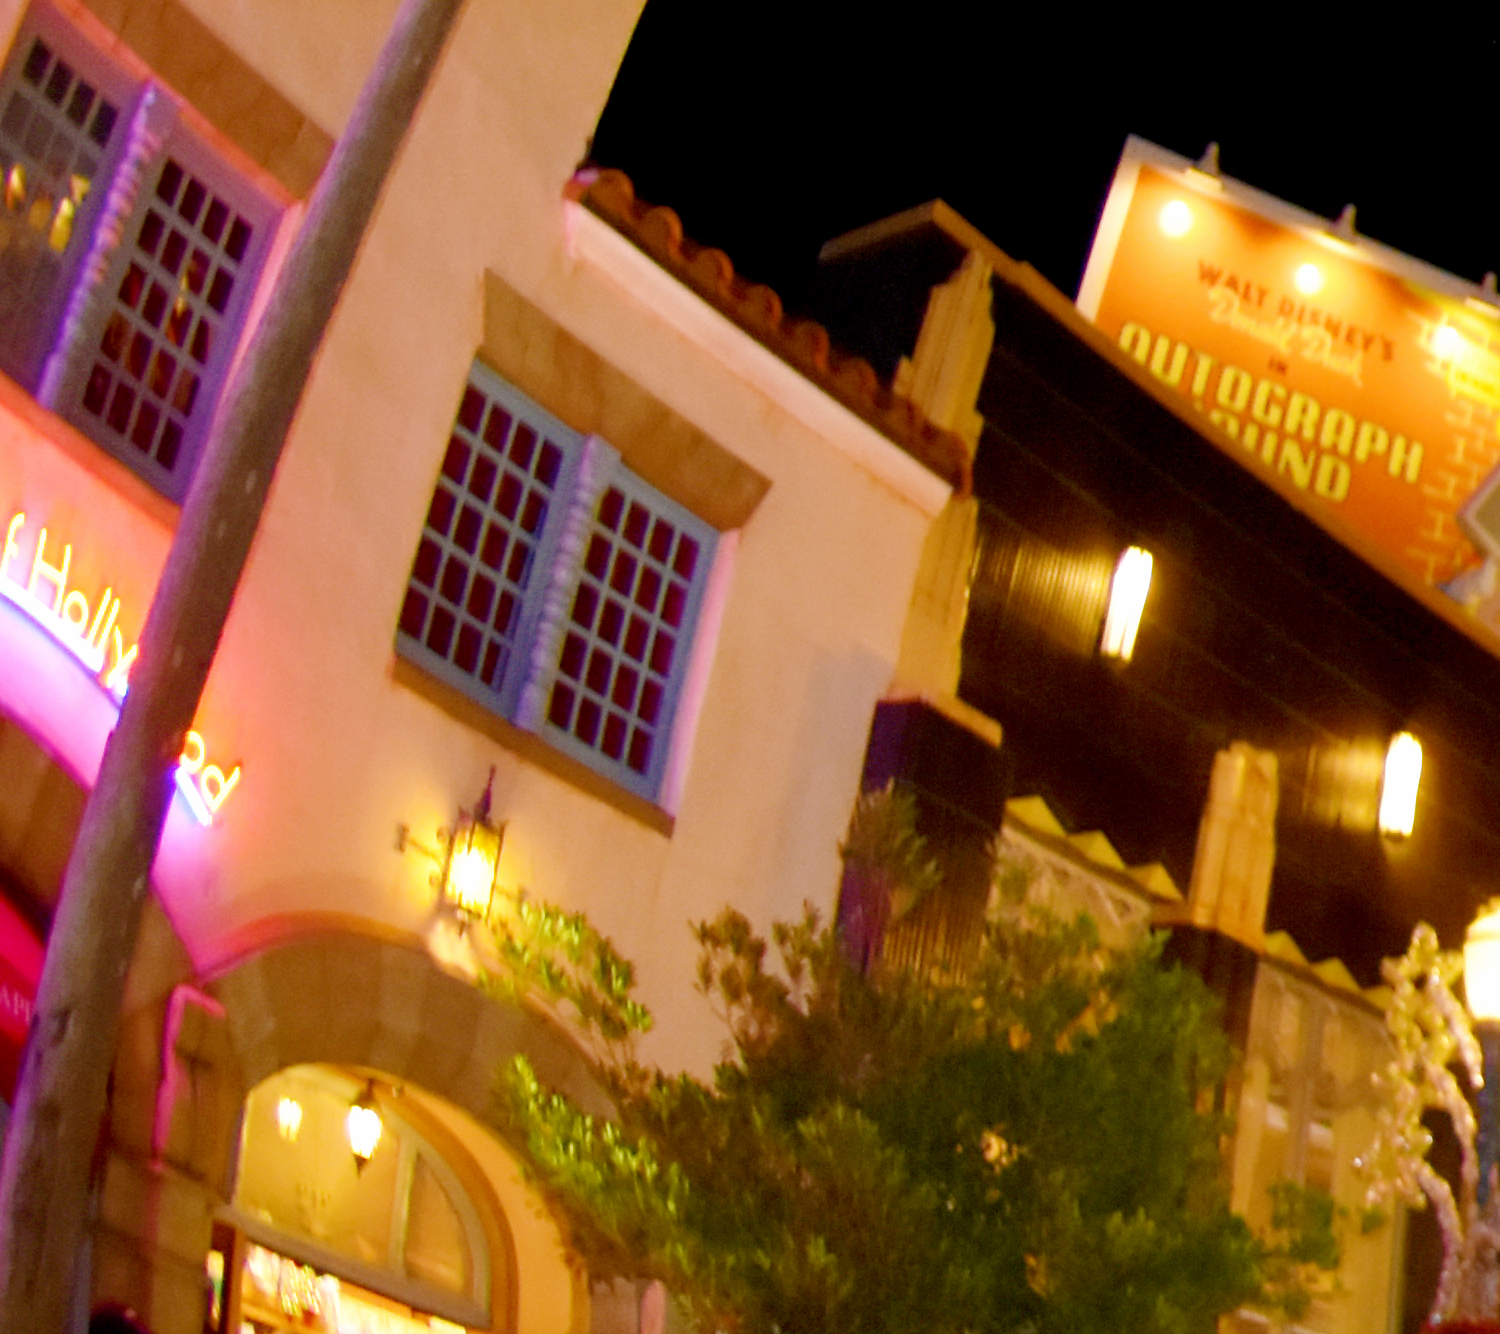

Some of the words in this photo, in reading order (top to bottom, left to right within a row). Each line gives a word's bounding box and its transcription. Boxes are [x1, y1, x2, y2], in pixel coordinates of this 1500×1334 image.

[1198, 261, 1267, 307] WALT
[1277, 296, 1394, 363] DISNEY'S
[1118, 321, 1424, 485] AUTOGRAPH
